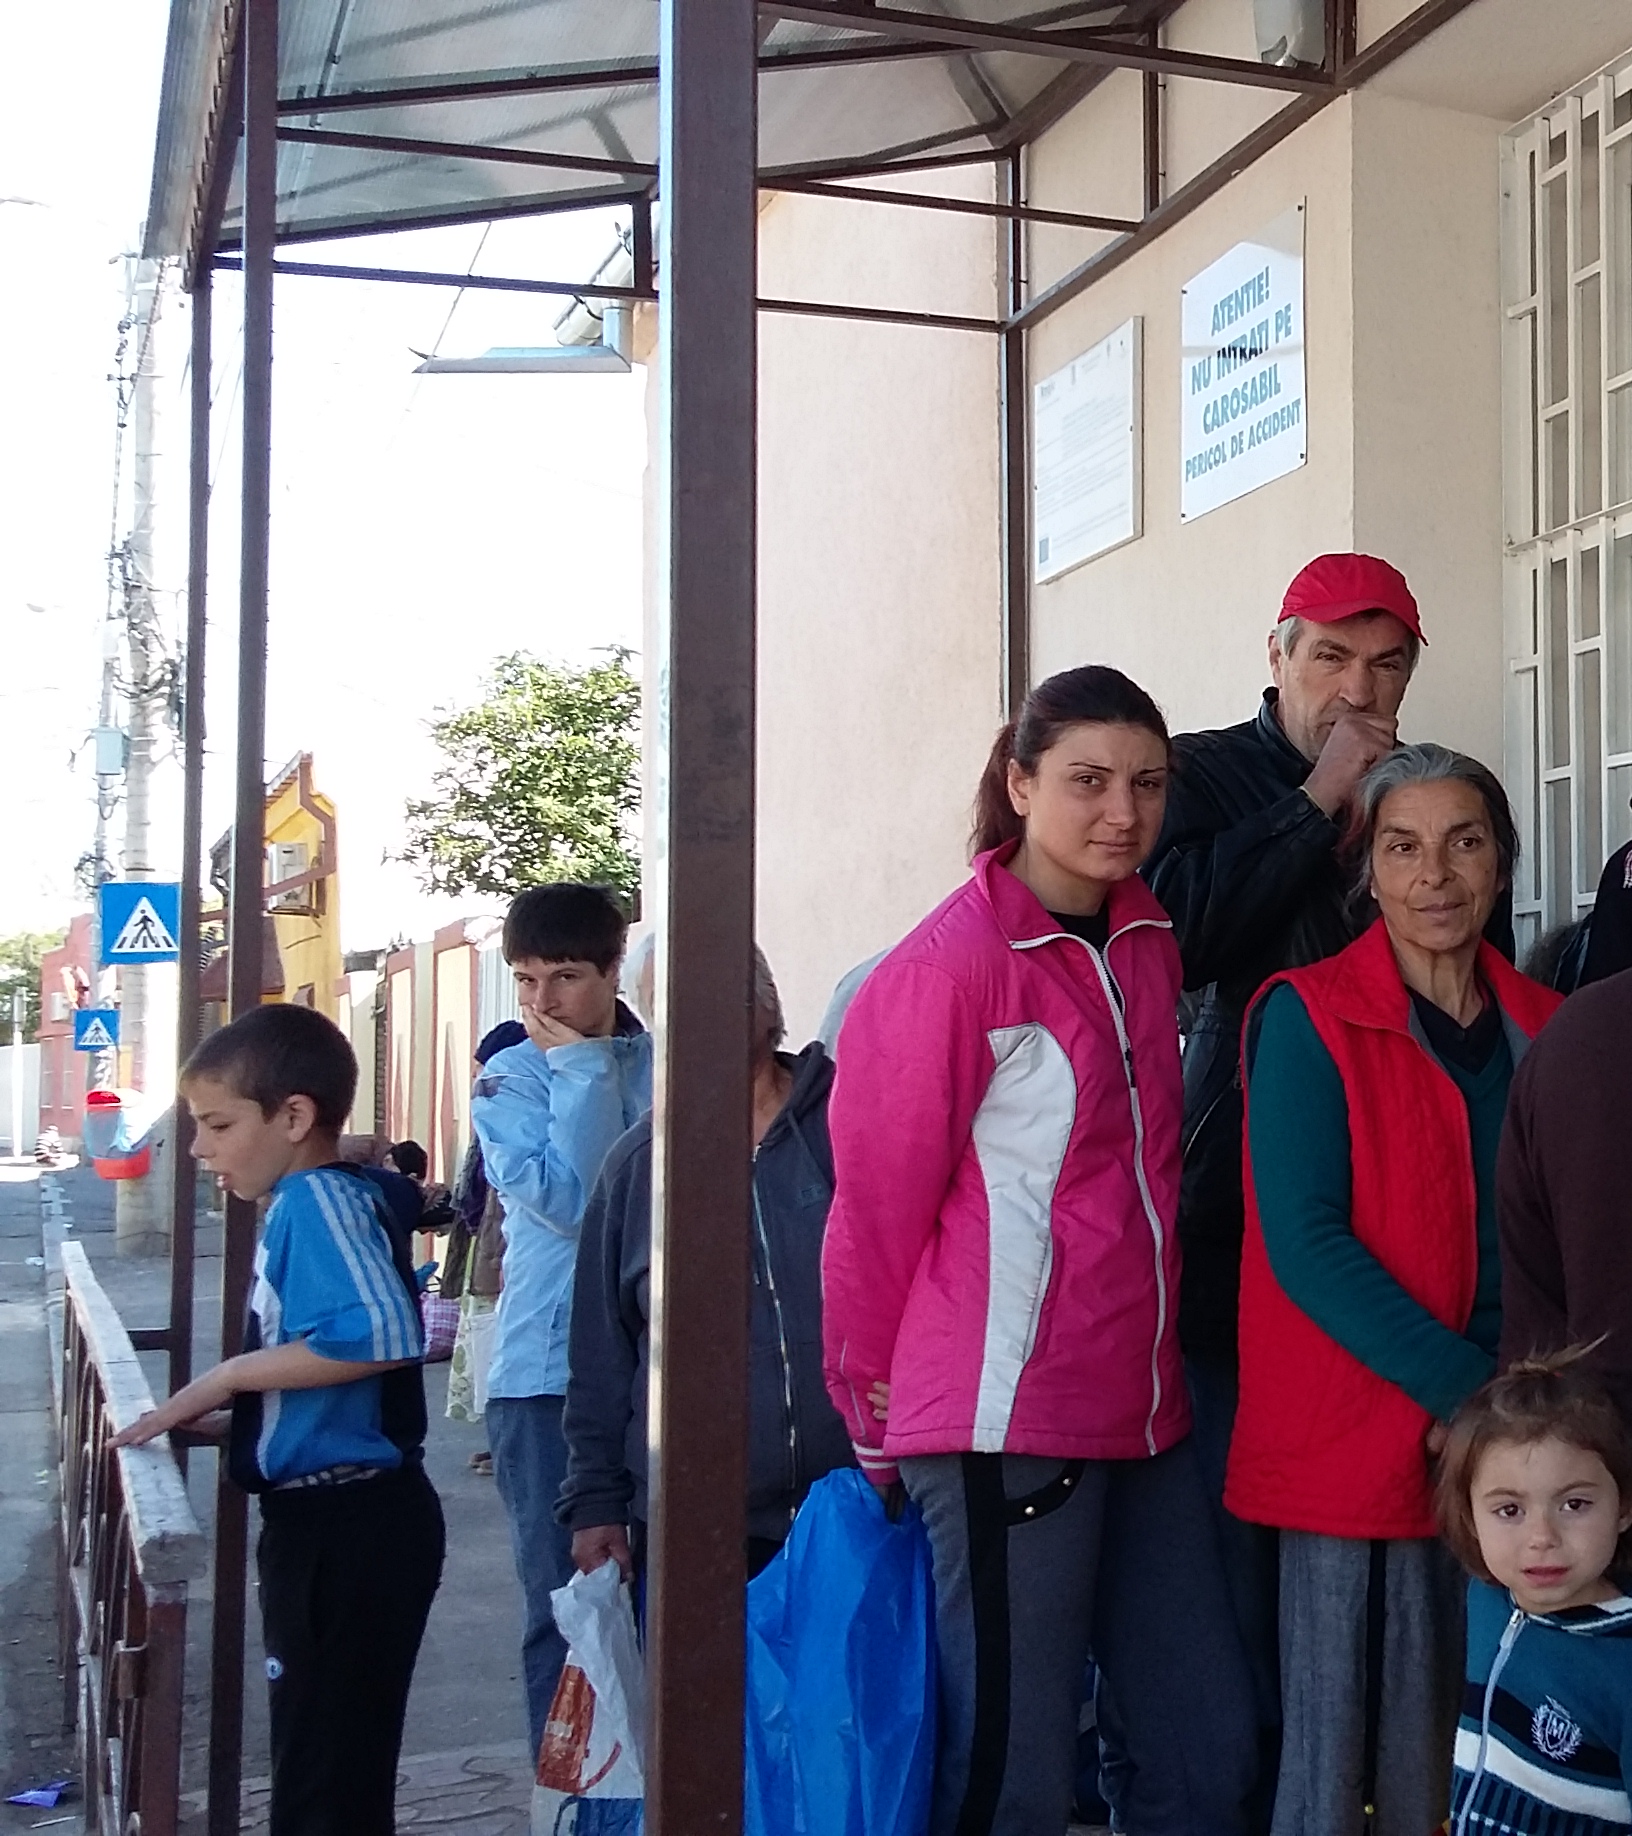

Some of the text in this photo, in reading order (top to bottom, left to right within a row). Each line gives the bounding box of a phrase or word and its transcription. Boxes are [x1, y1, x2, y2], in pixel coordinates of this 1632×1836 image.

[1211, 265, 1270, 337] ATENTIE!
[1191, 302, 1292, 396] NU INTRATI PE
[1203, 362, 1281, 435] CAROSABIL
[1185, 397, 1301, 483] PERICOL DE ACCIDENT
